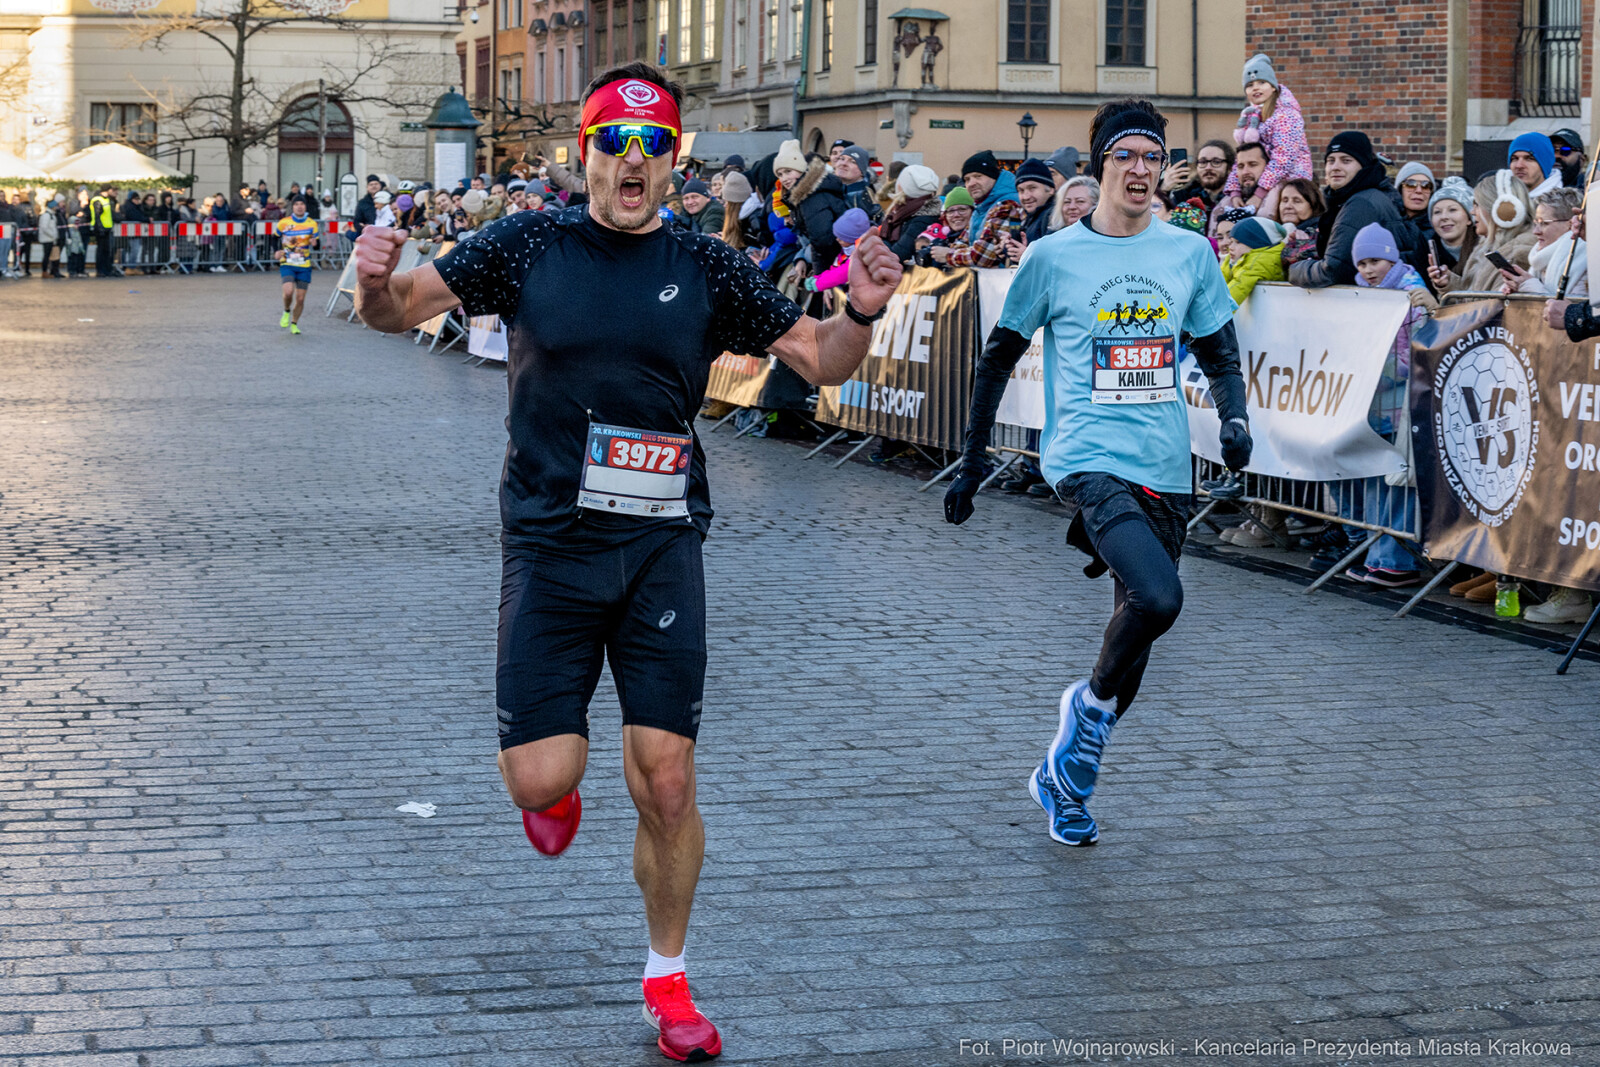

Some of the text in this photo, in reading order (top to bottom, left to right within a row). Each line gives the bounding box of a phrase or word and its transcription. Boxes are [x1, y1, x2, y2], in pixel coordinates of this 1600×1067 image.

[1089, 274, 1175, 308] XXI BIEG SKAWIŃSKI
[1113, 347, 1162, 368] 3587
[1434, 329, 1484, 399] FUNDACJA
[1485, 326, 1514, 345] VENA
[1519, 348, 1540, 403] SPORT
[1030, 366, 1043, 382] Kra
[1118, 371, 1157, 387] KAMIL
[1247, 348, 1354, 417] Kraków
[880, 385, 926, 418] SPORT
[592, 427, 602, 435] 20.
[602, 428, 642, 440] KRAKOWSKI
[641, 433, 657, 442] BIEG
[612, 441, 677, 472] 3972
[1434, 412, 1478, 518] ORGANIZACJA
[1503, 421, 1540, 520] SPORTOWYCH
[1564, 441, 1600, 472] OR
[1558, 516, 1600, 550] SPO
